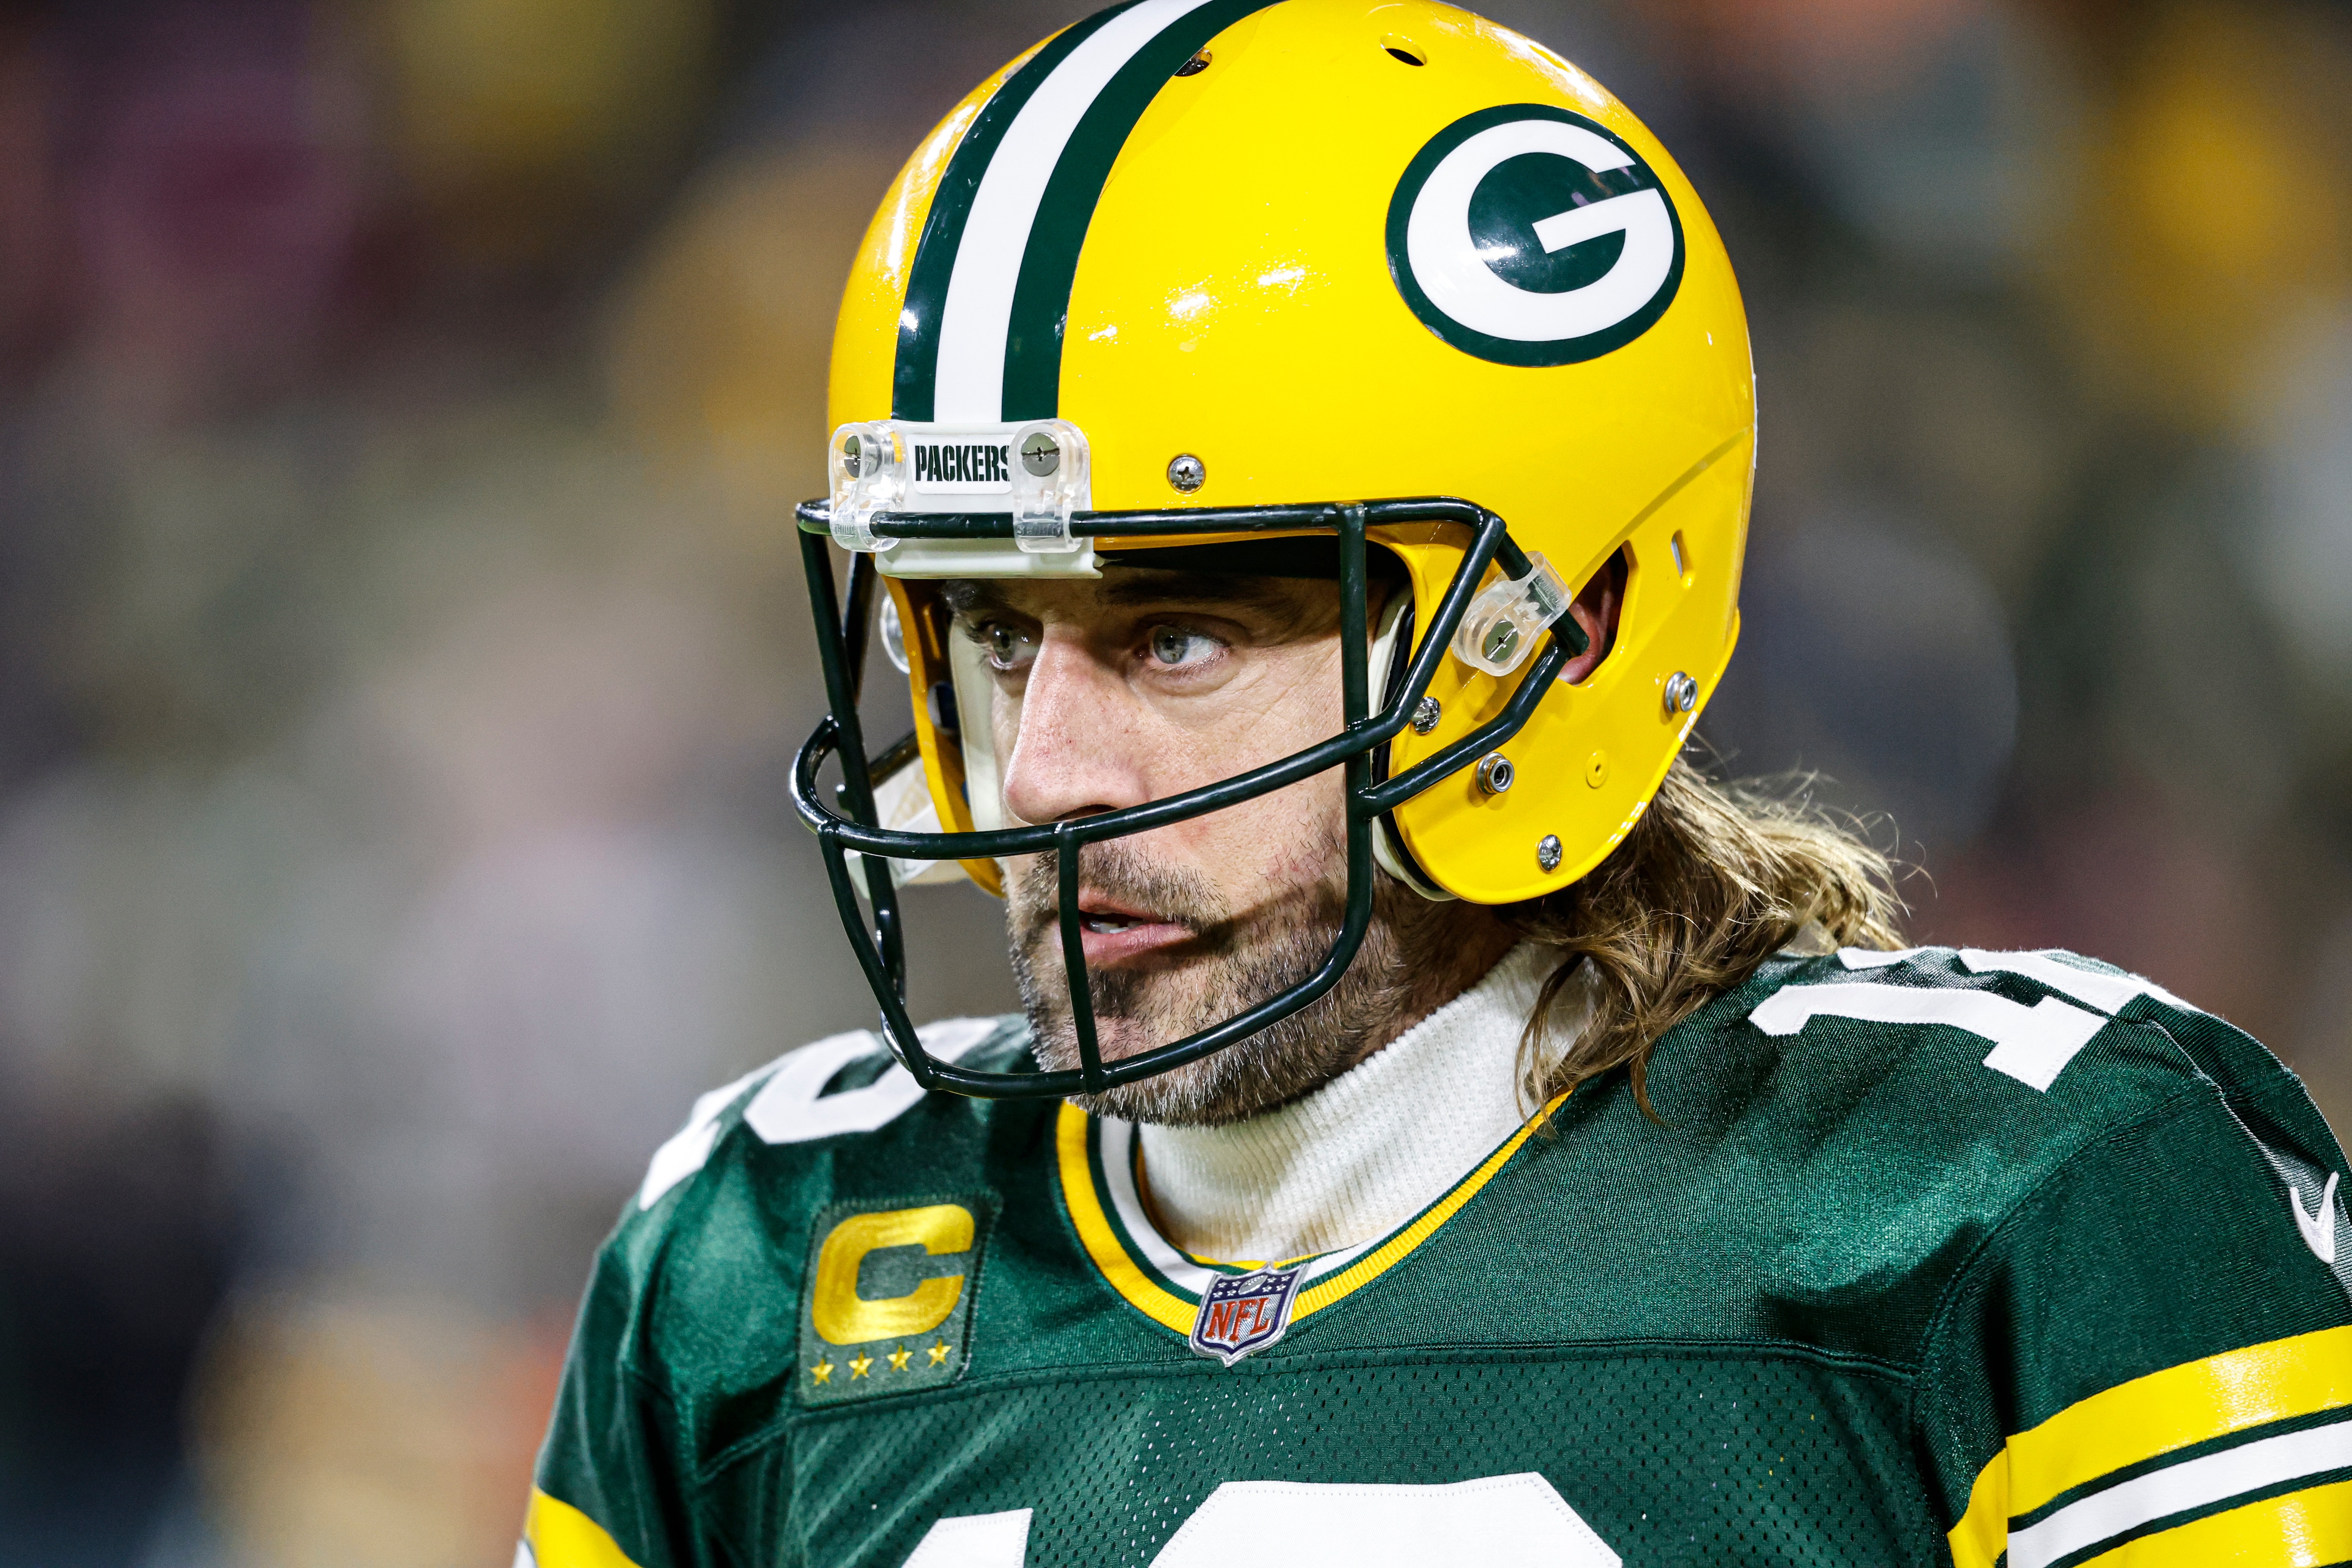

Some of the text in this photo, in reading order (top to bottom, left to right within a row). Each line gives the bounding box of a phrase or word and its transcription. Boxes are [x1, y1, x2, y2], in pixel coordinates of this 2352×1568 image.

[1407, 119, 1674, 341] G
[914, 445, 1010, 482] PACKERS
[812, 1204, 975, 1345] C
[1205, 1297, 1271, 1343] NFL
